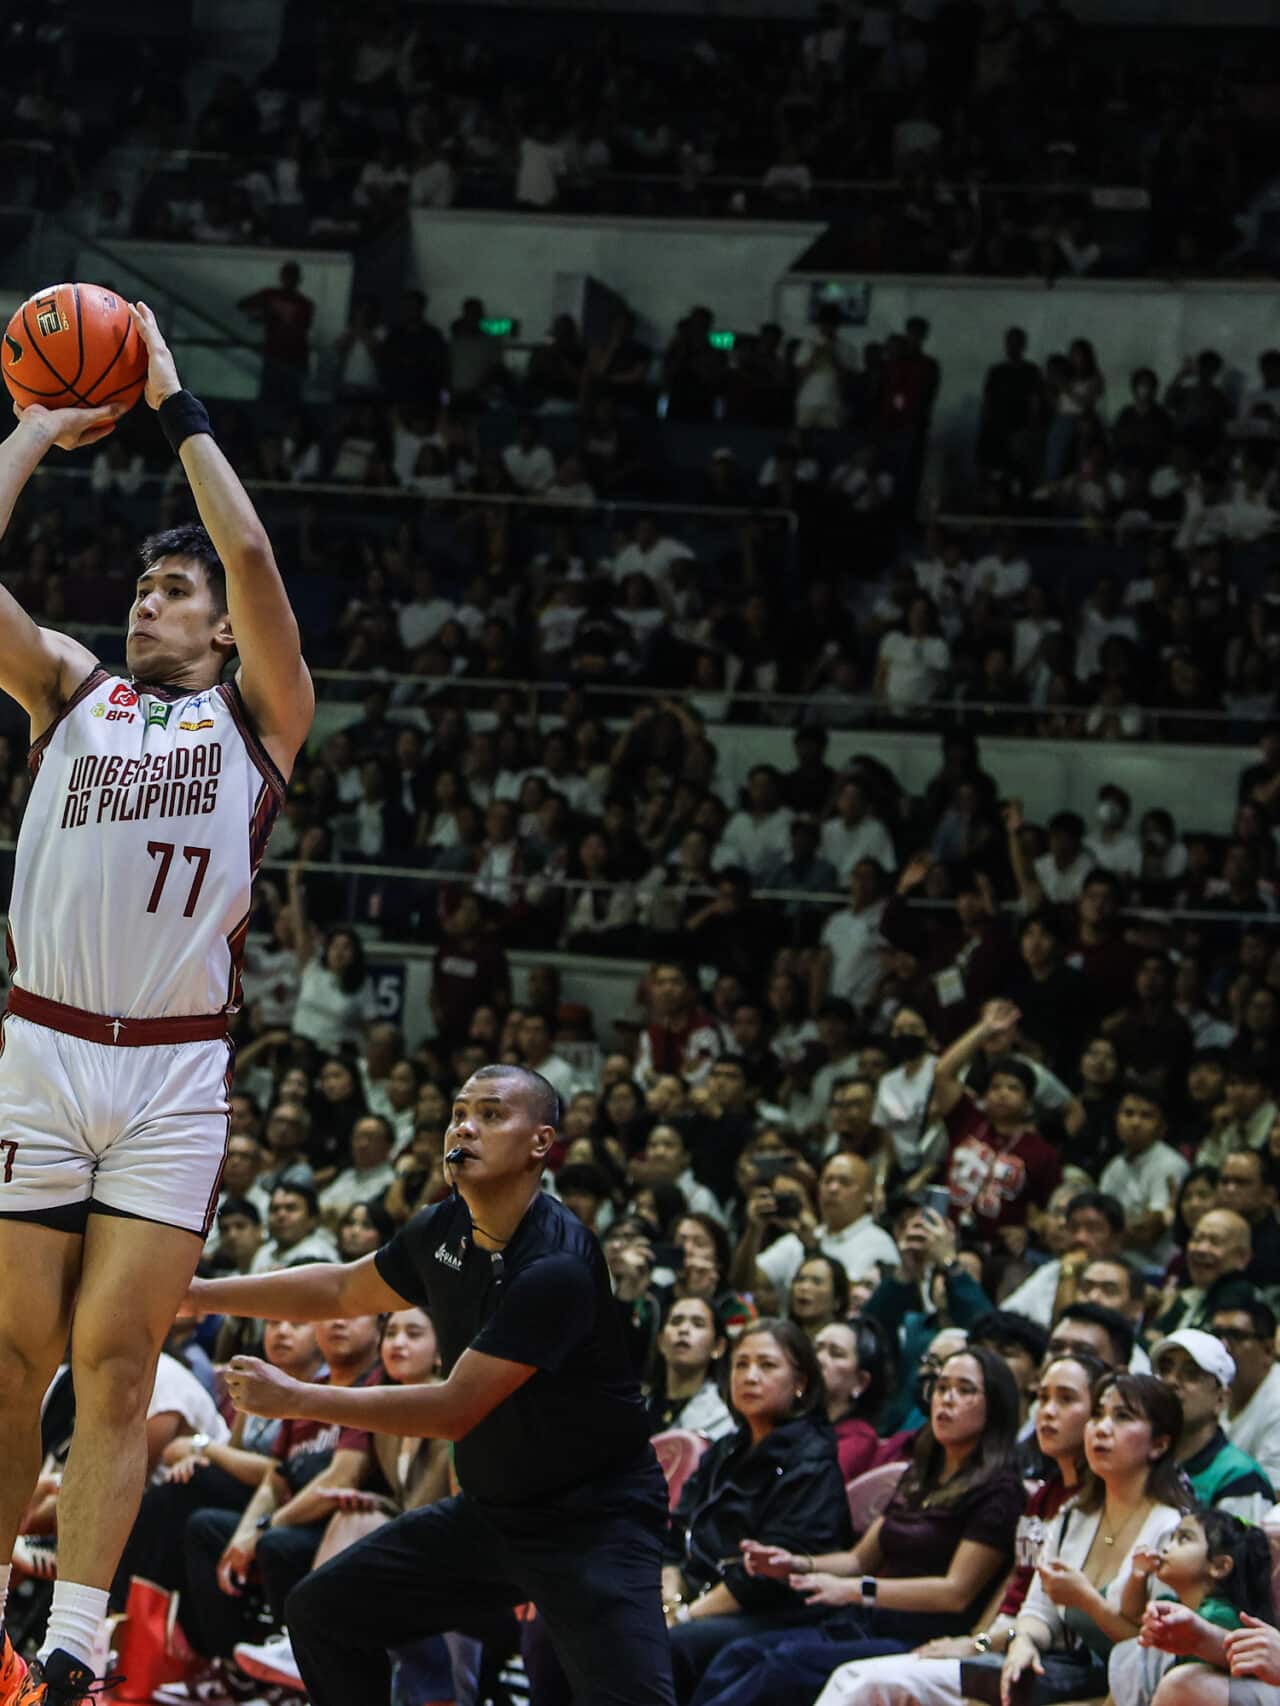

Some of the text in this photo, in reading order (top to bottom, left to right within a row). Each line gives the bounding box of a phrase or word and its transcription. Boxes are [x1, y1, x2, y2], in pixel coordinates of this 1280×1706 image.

[105, 710, 135, 724] BPI
[68, 742, 222, 792] UNIBERSIDAD
[60, 778, 219, 829] NG PILIPINAS
[146, 840, 211, 918] 77
